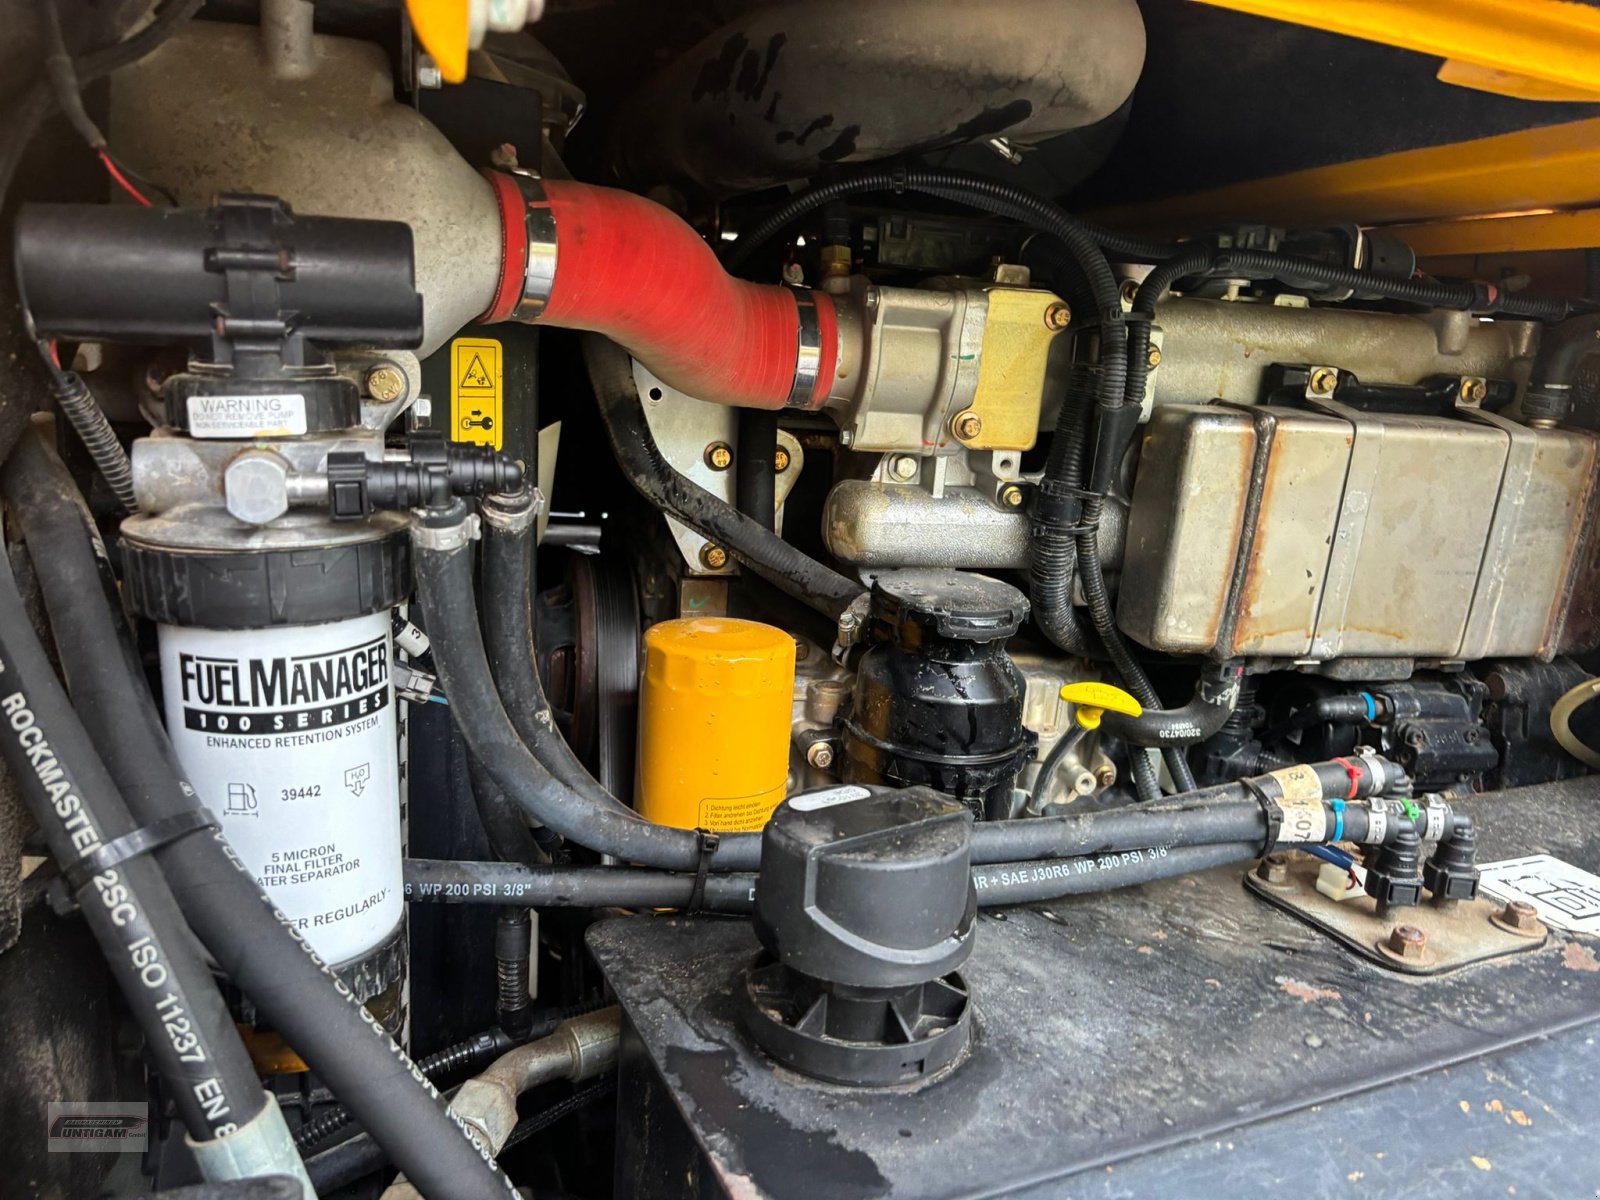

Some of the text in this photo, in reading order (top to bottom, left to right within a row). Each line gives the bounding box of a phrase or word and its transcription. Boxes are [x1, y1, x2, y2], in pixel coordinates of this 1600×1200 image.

[193, 412, 205, 421] DO
[225, 411, 265, 421] REMOVE
[268, 410, 294, 419] PUMP
[200, 398, 282, 412] WARNING
[267, 419, 289, 428] PART
[199, 692, 382, 732] 100 SERIES
[206, 715, 379, 749] ENHANCED RETENTION SYSTEM
[281, 784, 322, 802] 39442
[271, 843, 336, 863] 5 MICRON
[264, 853, 343, 875] FINAL FILTER
[290, 858, 361, 885] SEPARATOR
[1001, 870, 1029, 886] SAE
[1031, 863, 1070, 882] J30R6
[1074, 859, 1096, 875] WP
[1097, 854, 1120, 872] 200
[1121, 849, 1144, 866] PSI
[420, 883, 442, 896] WP
[445, 884, 470, 896] 200
[473, 884, 497, 896] PSI
[93, 869, 138, 927] 2SC
[127, 936, 168, 989] ISO
[155, 993, 206, 1063] 11237
[193, 1077, 231, 1121] EN
